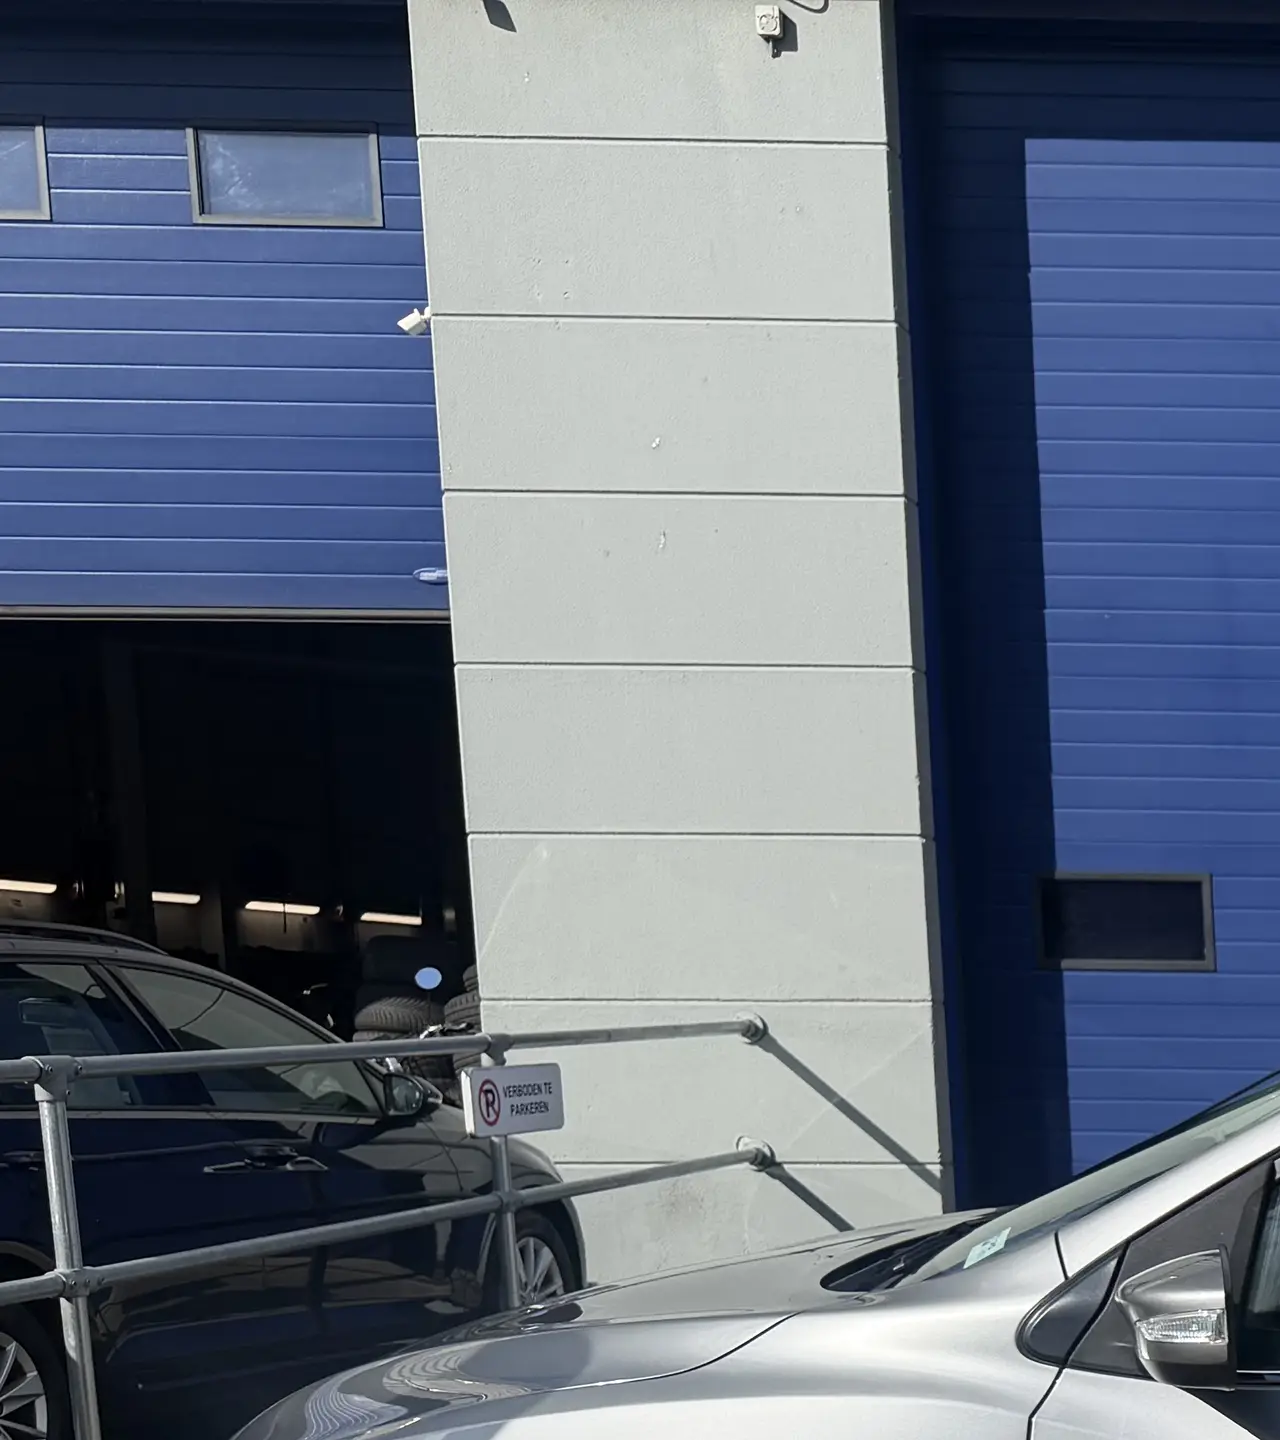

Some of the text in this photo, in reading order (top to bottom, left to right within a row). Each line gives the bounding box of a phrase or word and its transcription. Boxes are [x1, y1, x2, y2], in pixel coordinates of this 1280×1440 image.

[502, 1081, 553, 1098] VERBODEN TE
[510, 1101, 550, 1117] PARKEREN
